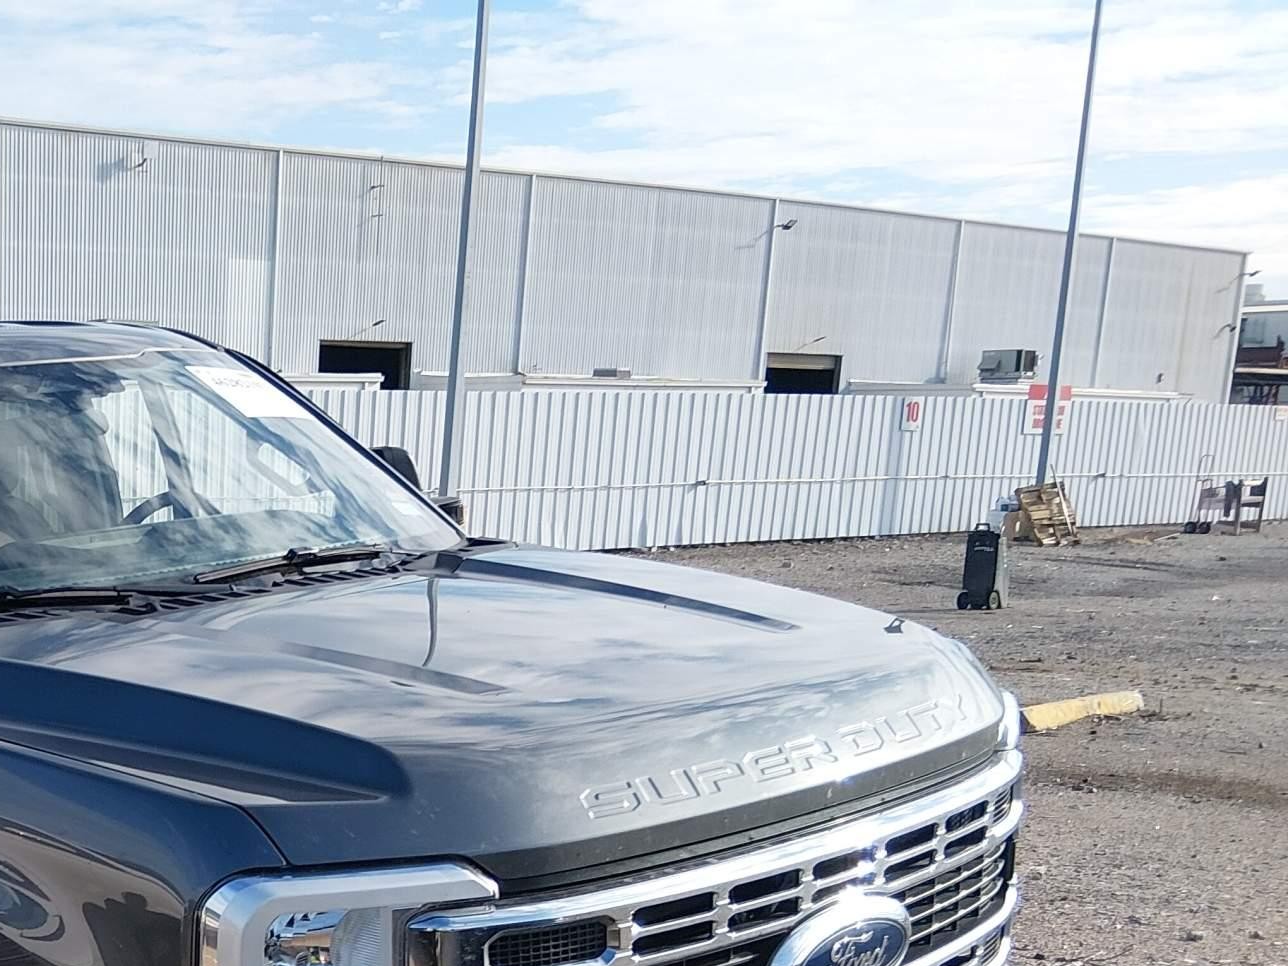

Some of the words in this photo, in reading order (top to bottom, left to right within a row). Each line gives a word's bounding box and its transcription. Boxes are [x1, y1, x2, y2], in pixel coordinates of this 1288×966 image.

[906, 401, 920, 423] 10
[579, 734, 838, 820] SUPER
[838, 693, 969, 757] DUTY
